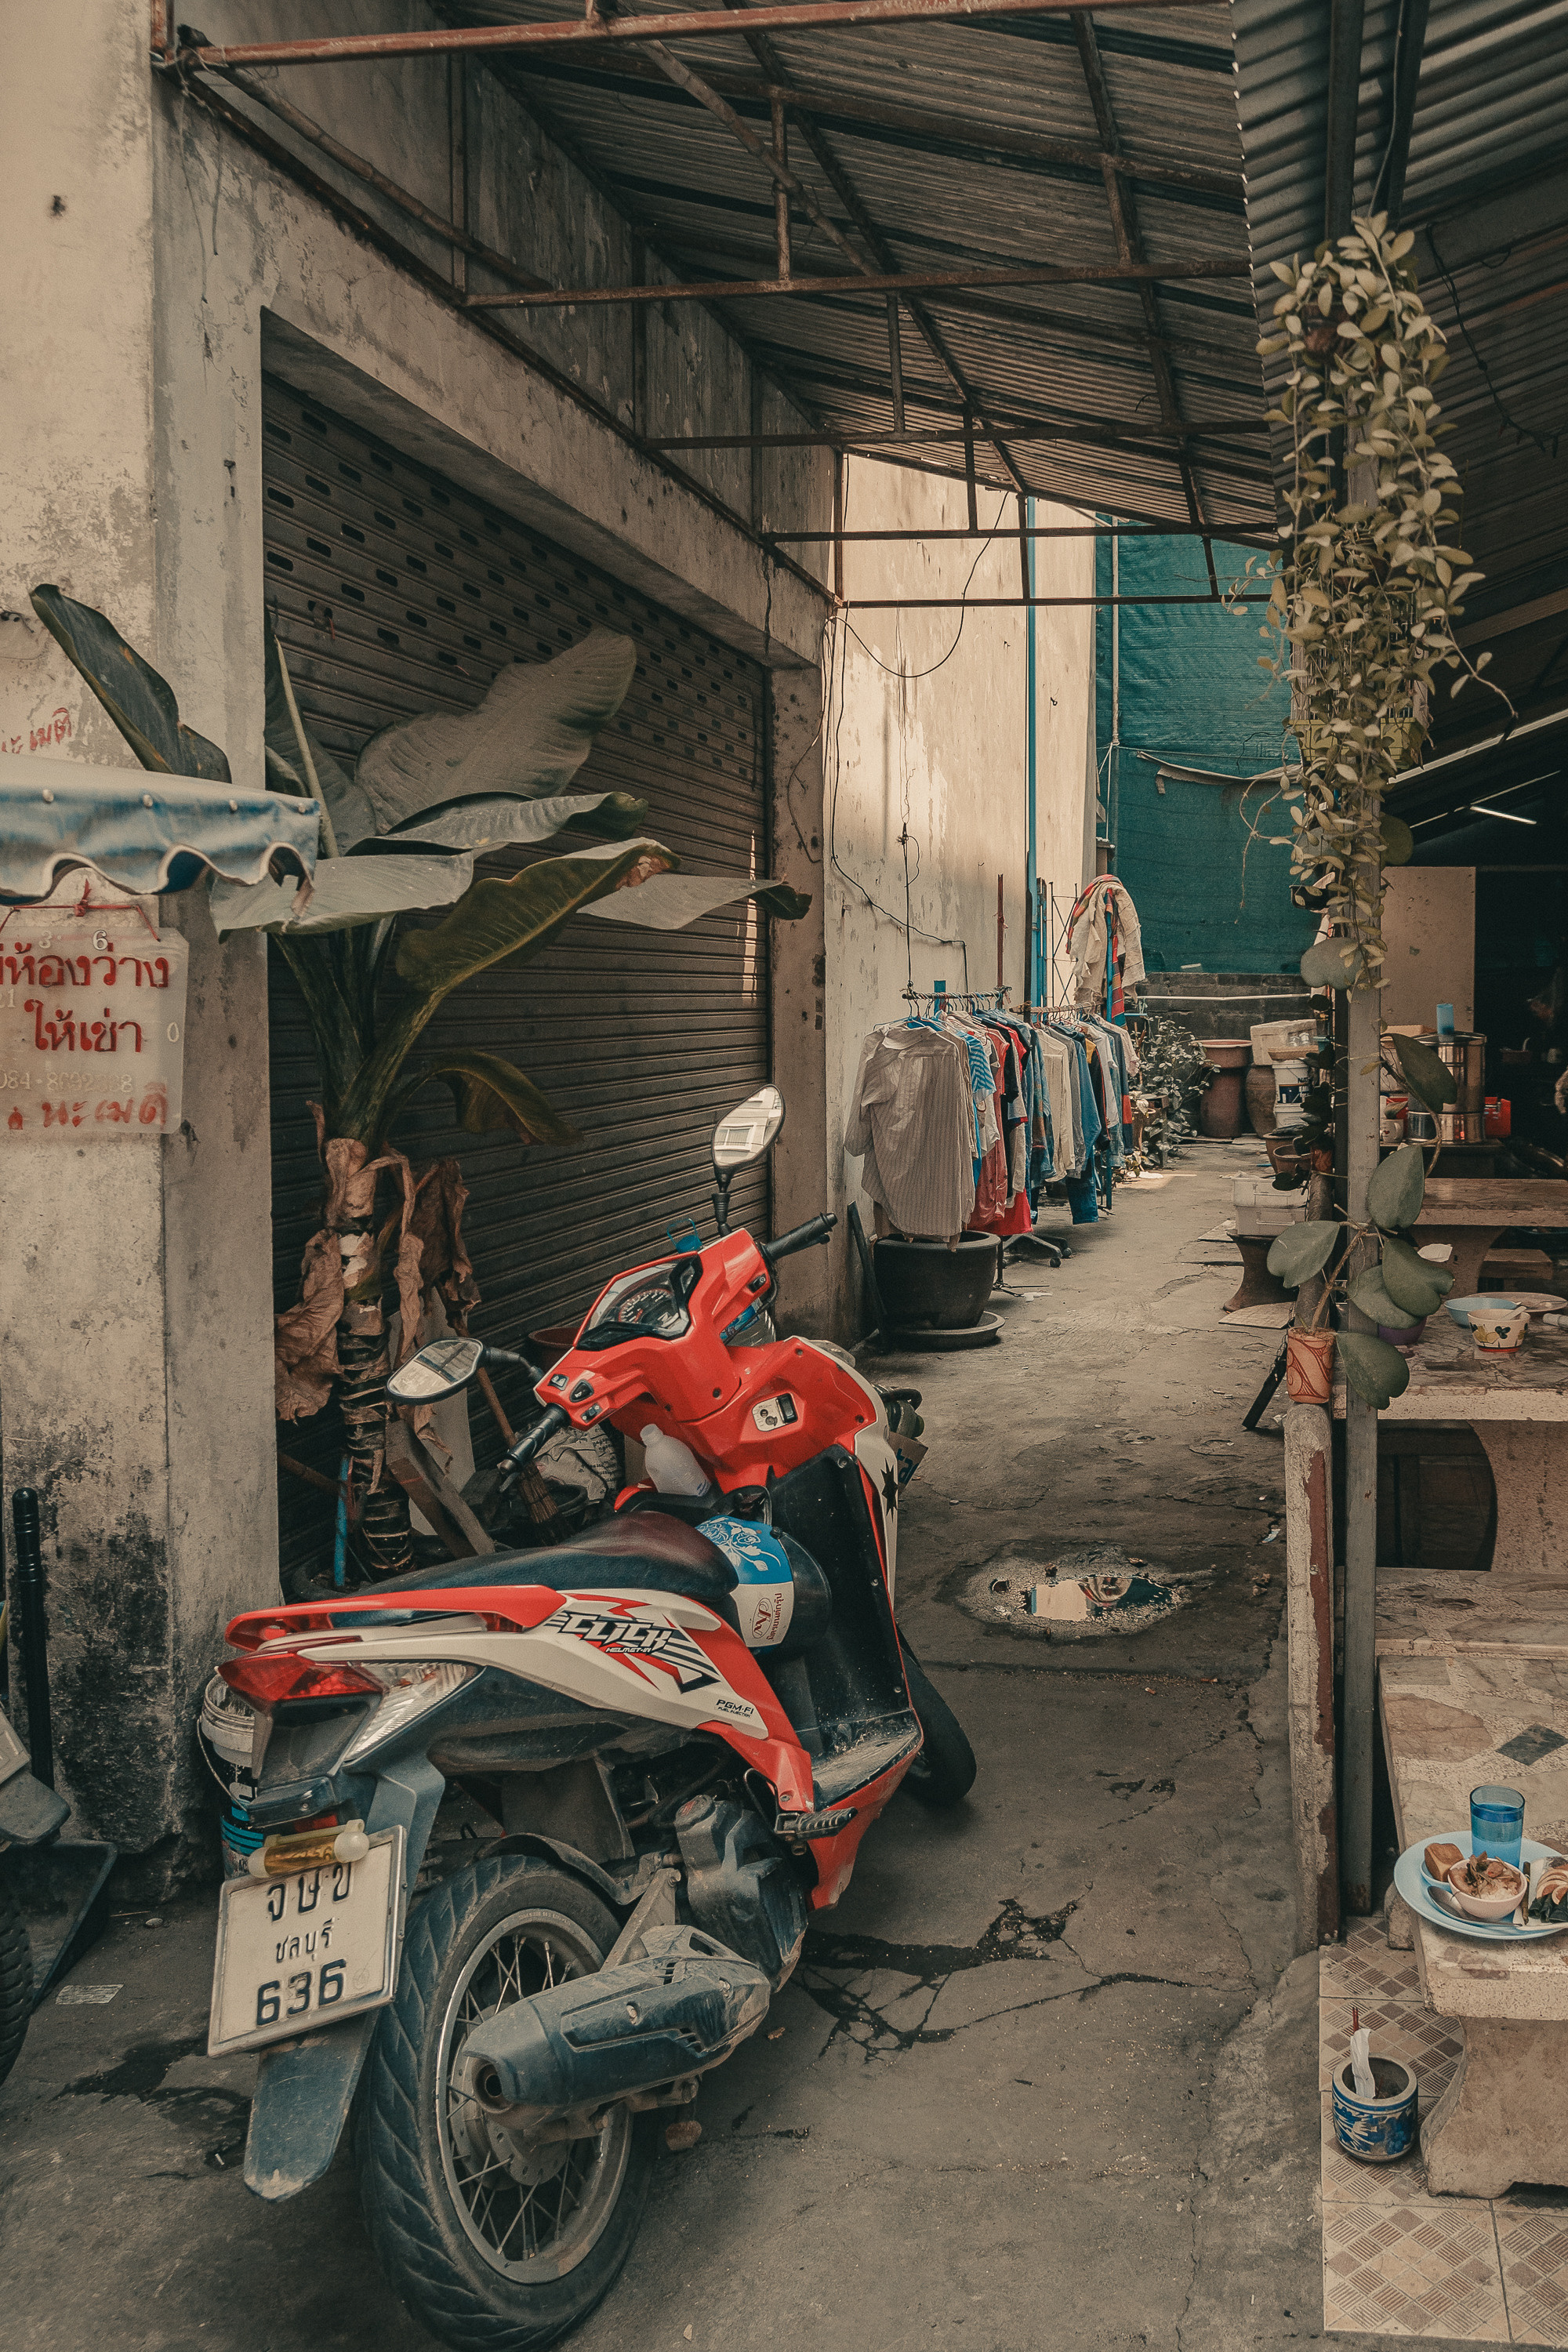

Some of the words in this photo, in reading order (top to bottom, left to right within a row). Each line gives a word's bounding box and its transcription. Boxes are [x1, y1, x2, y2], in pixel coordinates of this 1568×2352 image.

[0, 942, 169, 988] ห้องว่าง
[24, 998, 143, 1053] ให้เช่า
[275, 1918, 336, 1964] ชลบุรี
[256, 1958, 347, 2027] 636
